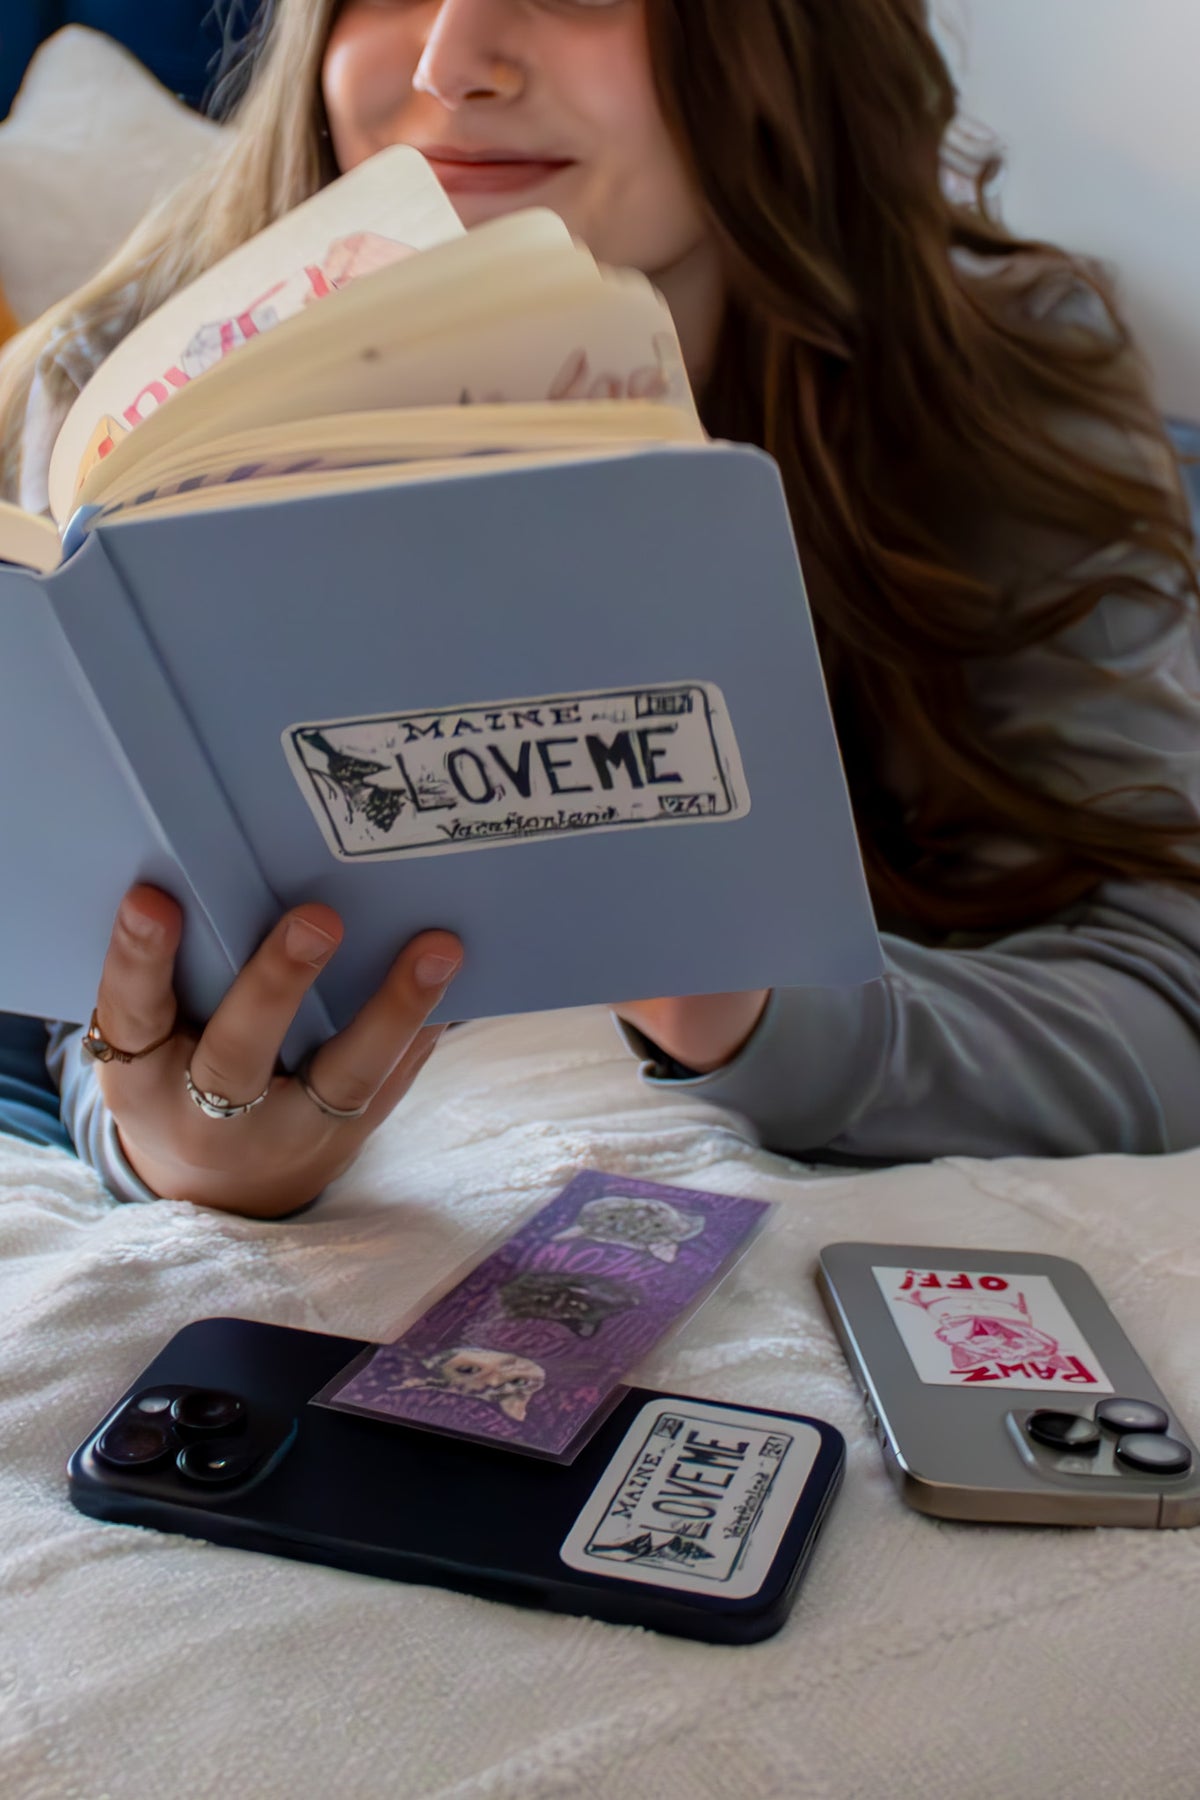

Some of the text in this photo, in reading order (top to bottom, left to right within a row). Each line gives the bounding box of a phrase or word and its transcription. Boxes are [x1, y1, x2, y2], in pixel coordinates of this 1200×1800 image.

[402, 704, 583, 743] MAINE
[899, 1270, 1009, 1291] OFF!
[950, 1356, 1098, 1384] PAWZ
[611, 1452, 663, 1520] MAINE
